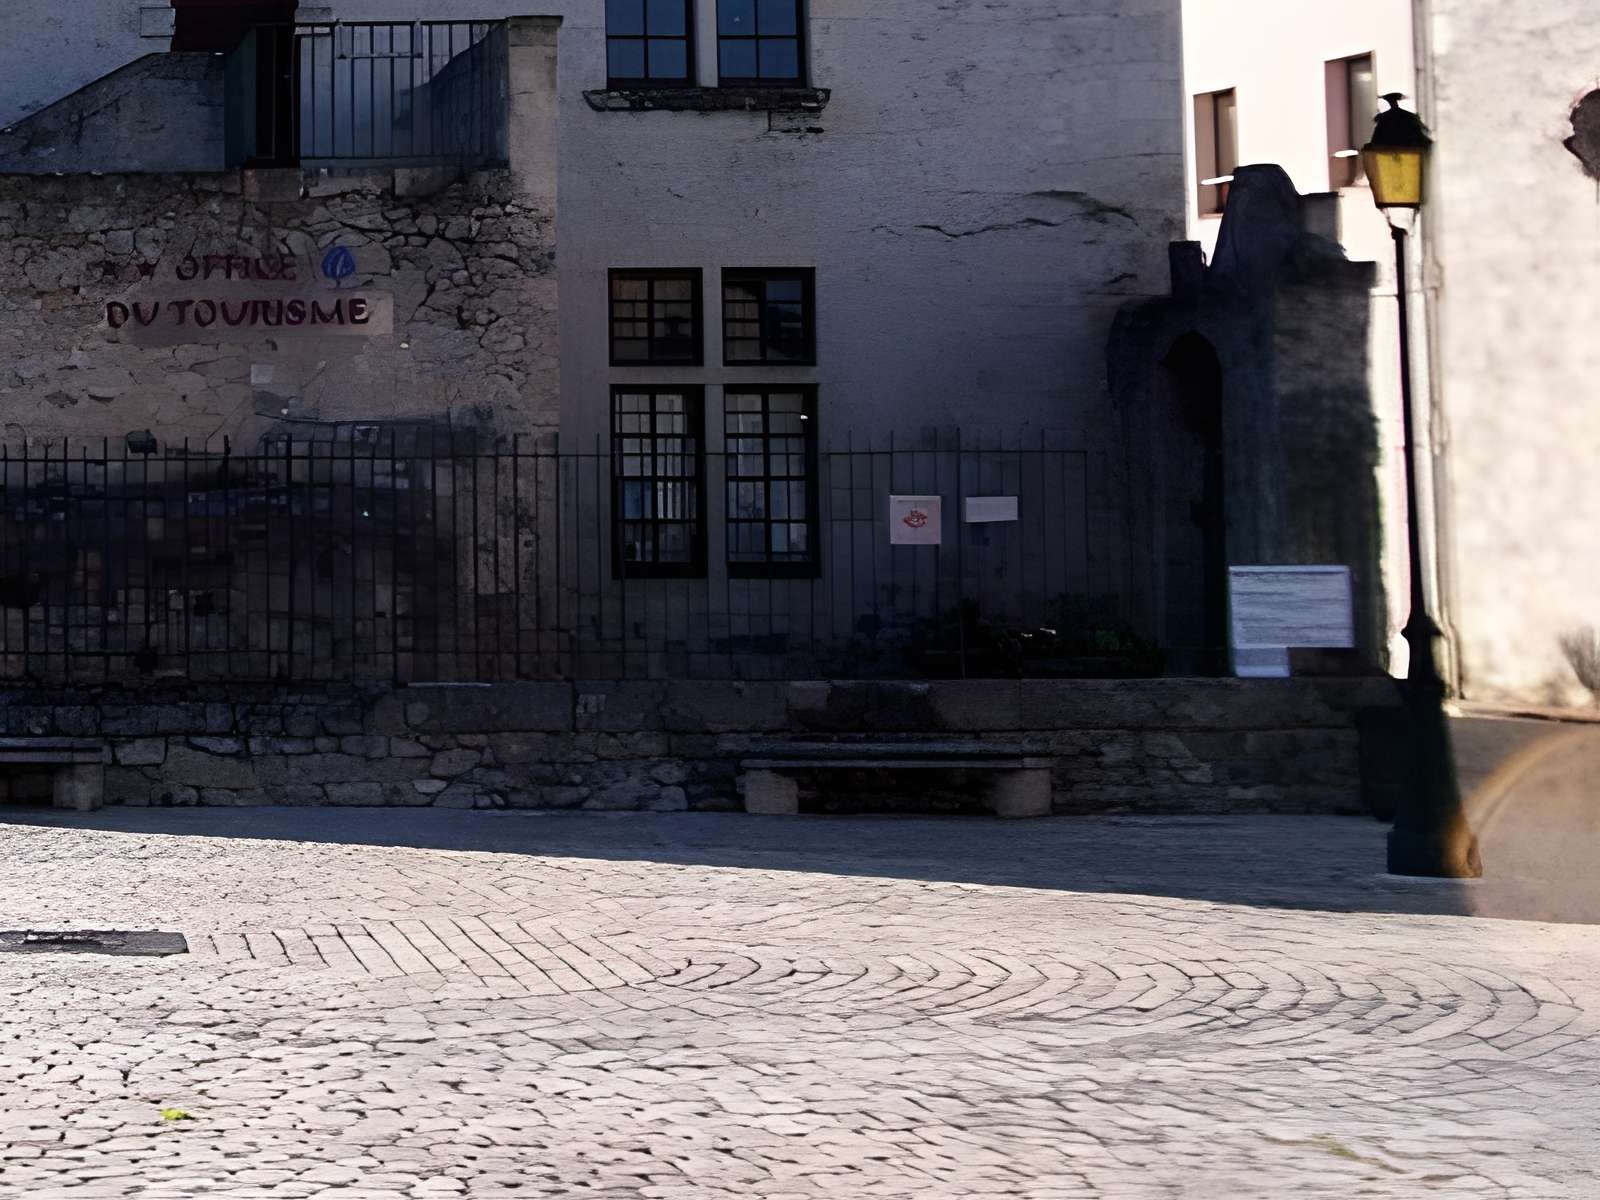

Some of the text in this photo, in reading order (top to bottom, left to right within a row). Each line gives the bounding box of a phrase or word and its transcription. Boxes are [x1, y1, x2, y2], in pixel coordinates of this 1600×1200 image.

[175, 254, 297, 281] OFFICE
[106, 298, 370, 328] DU TOURISME
